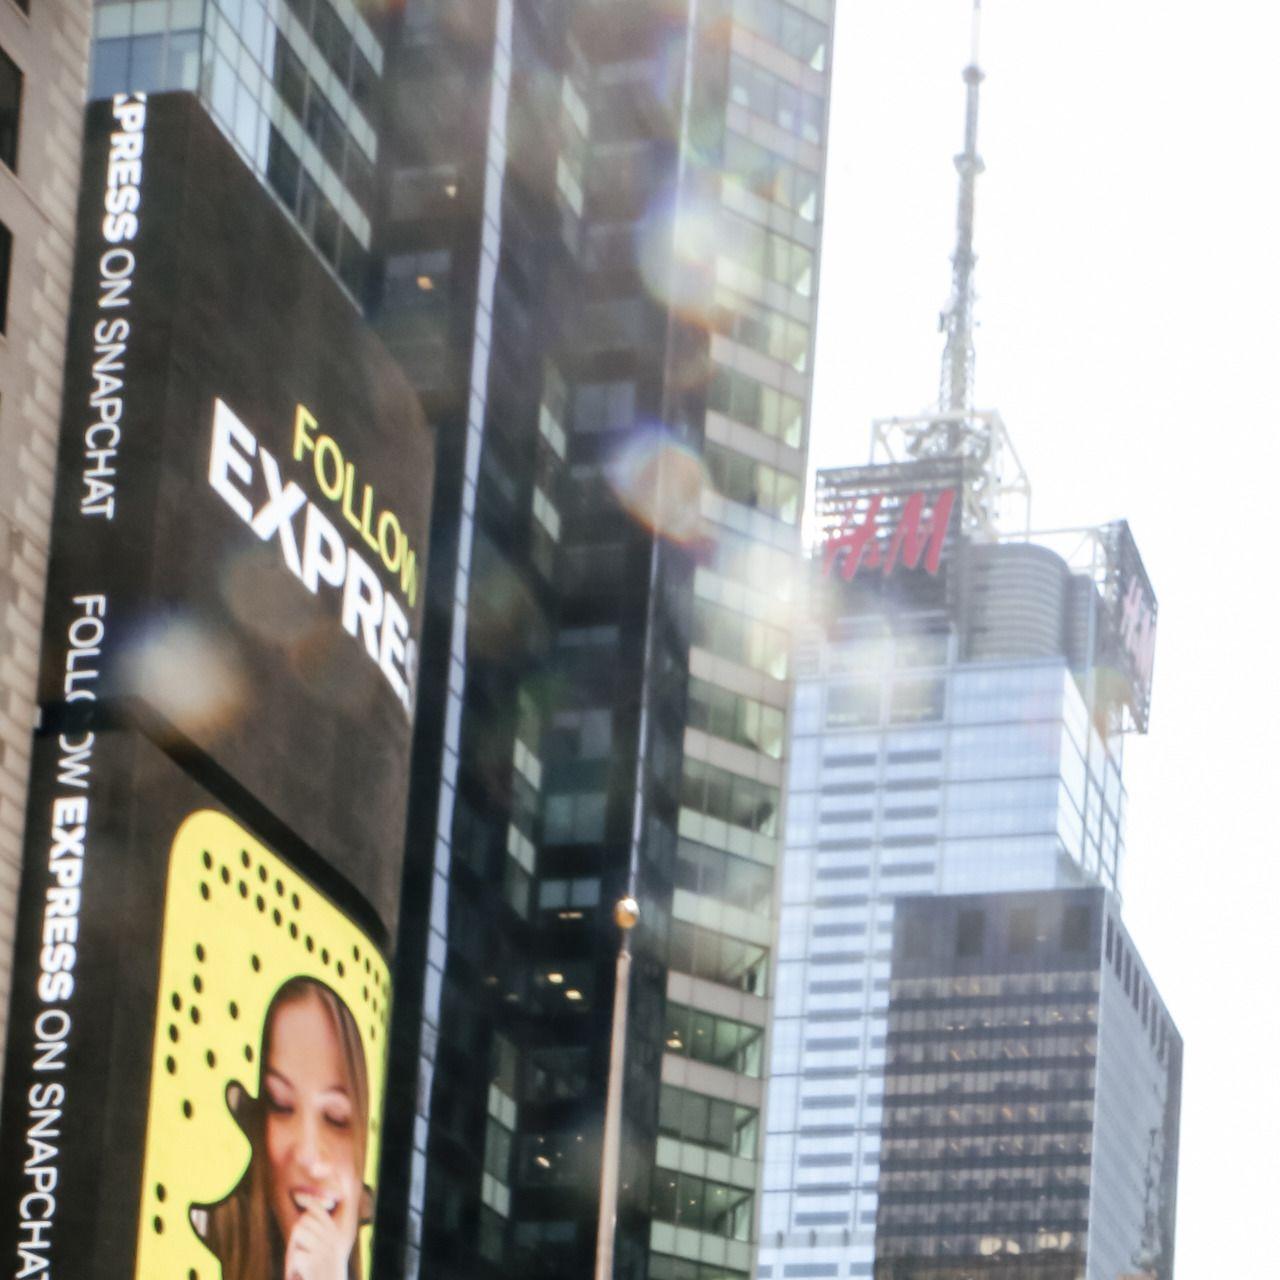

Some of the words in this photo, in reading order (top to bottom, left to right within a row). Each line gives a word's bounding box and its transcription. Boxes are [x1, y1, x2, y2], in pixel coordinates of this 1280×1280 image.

[98, 248, 135, 308] ON
[80, 319, 130, 522] SNAPCHAT
[37, 797, 88, 1001] EXPRESS
[34, 1009, 71, 1071] ON
